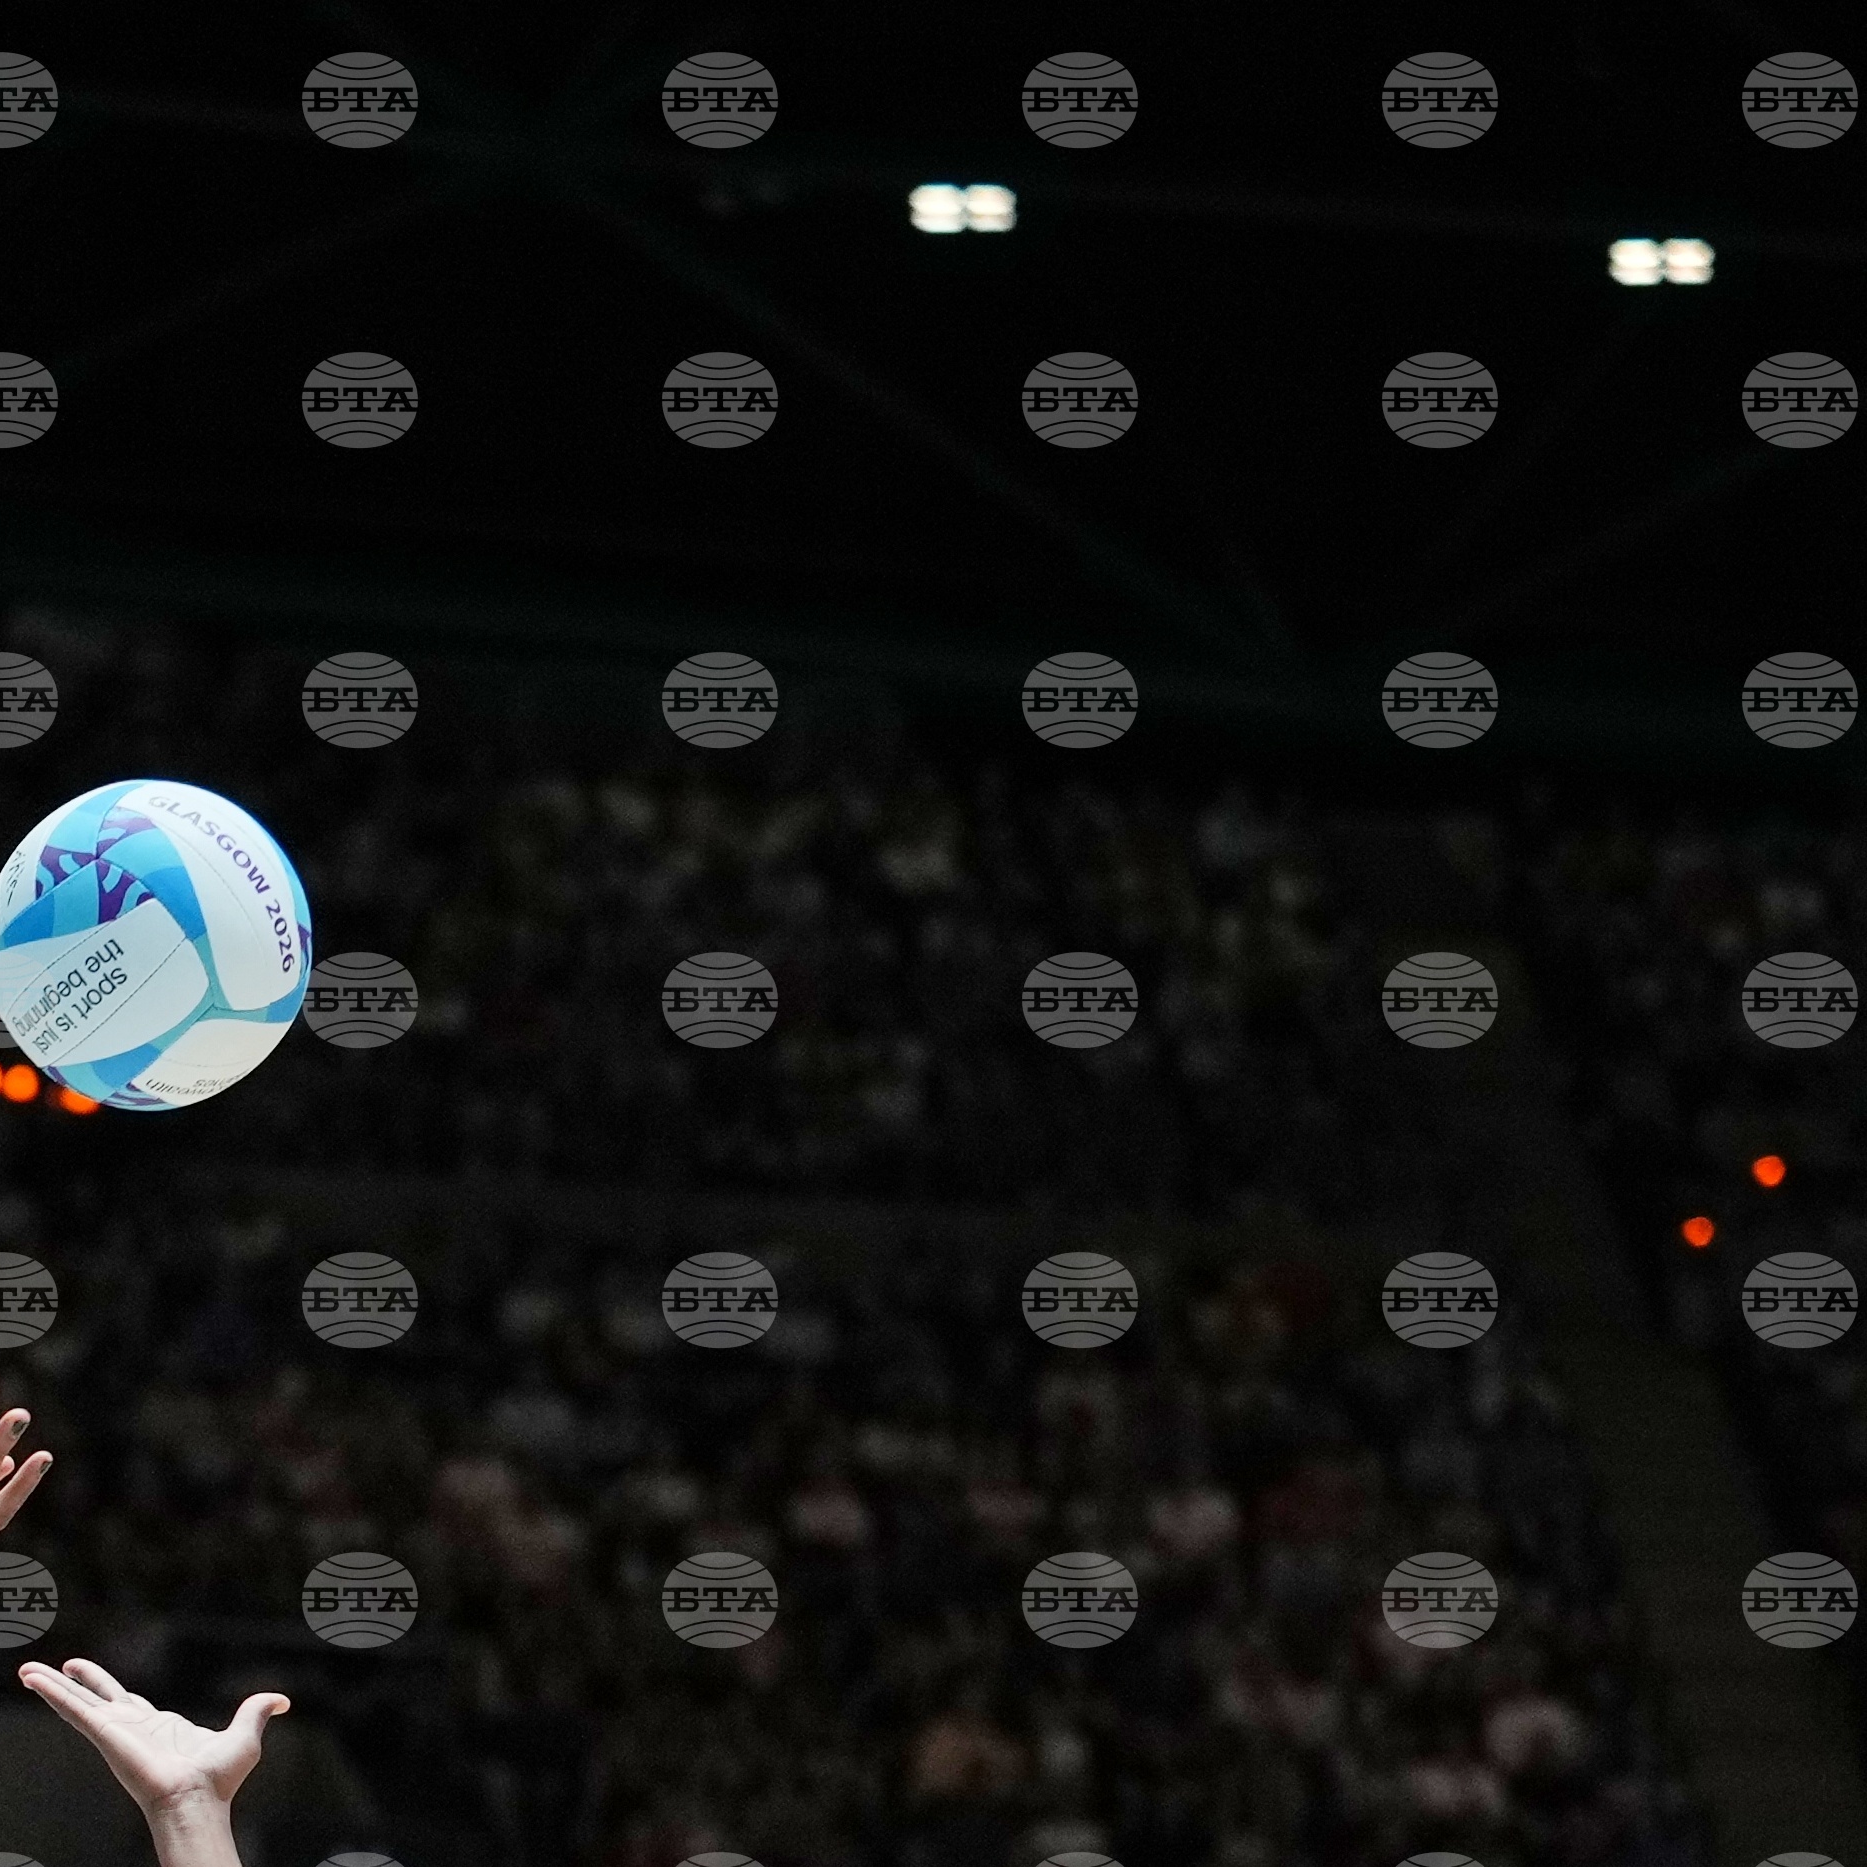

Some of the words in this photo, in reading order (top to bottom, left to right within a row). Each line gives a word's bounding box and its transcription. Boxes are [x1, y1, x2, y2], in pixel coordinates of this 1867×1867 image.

[148, 796, 270, 894] GLASGOW
[265, 899, 295, 973] 2026
[84, 938, 124, 973] the
[12, 969, 88, 1037] beginning
[71, 967, 128, 1019] sport
[32, 1022, 63, 1055] just
[55, 1013, 78, 1032] is
